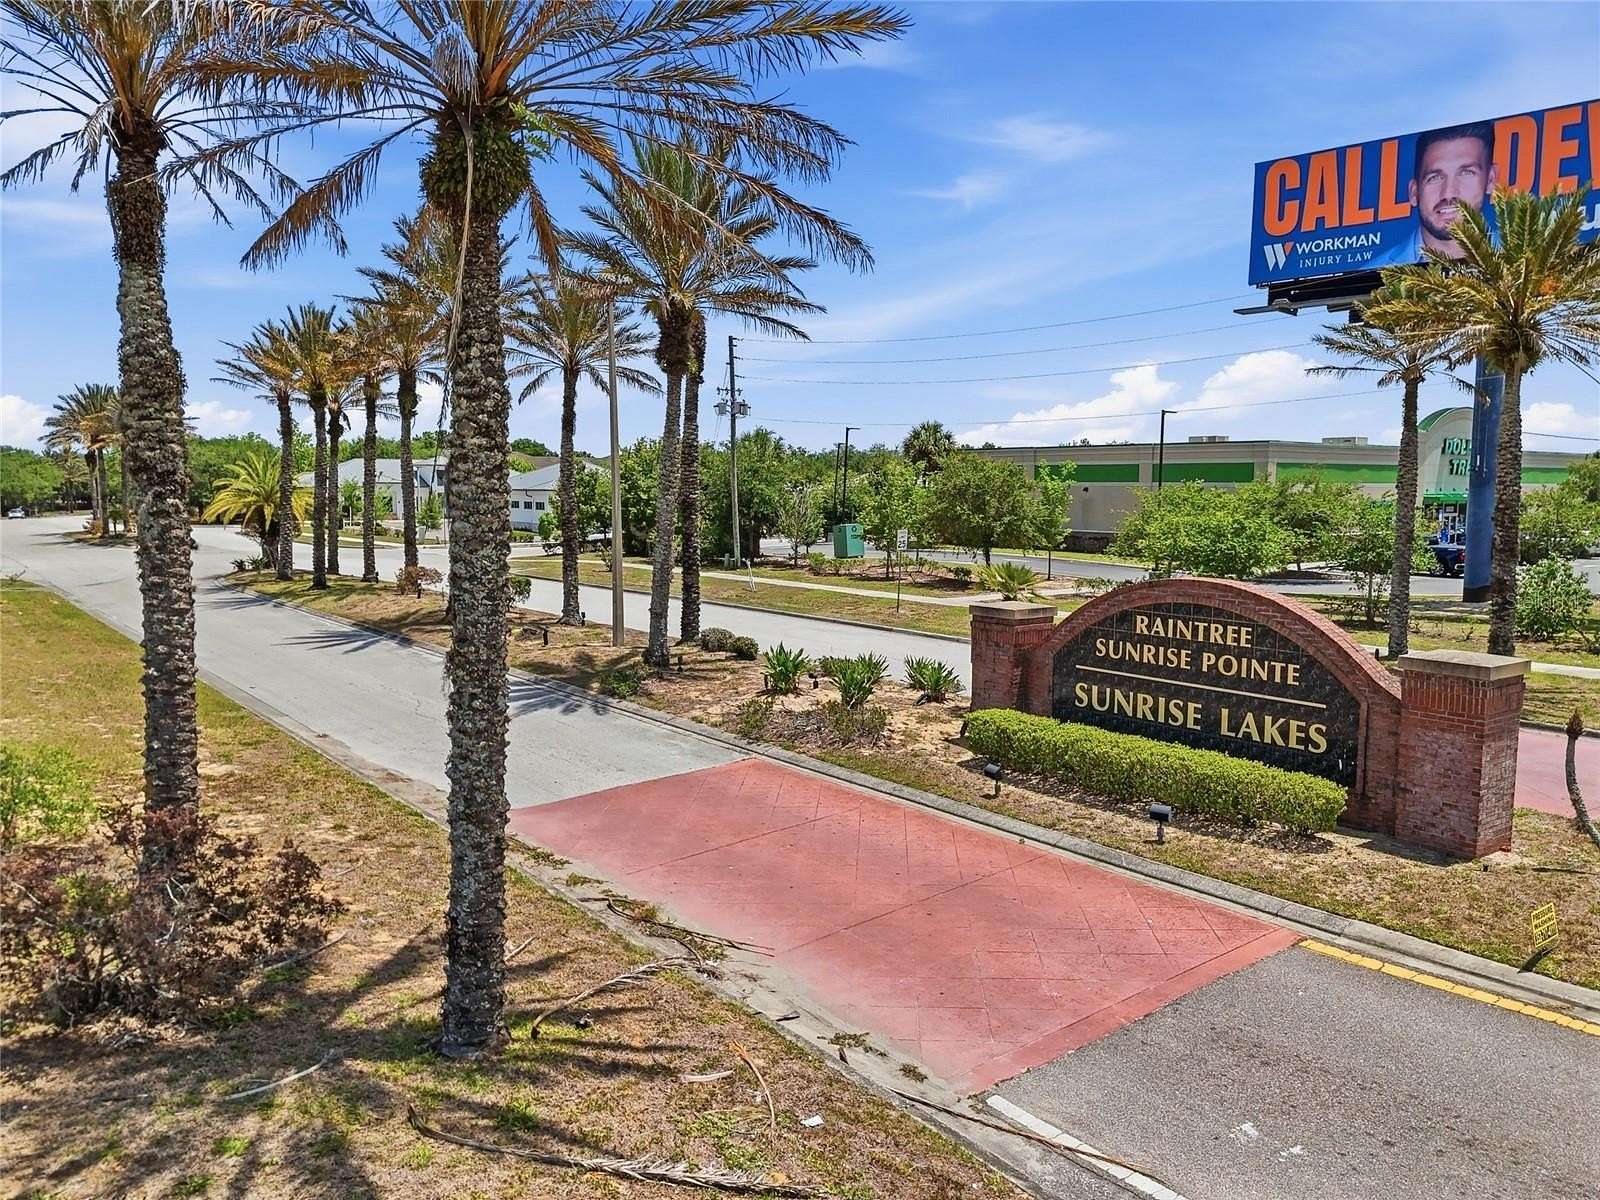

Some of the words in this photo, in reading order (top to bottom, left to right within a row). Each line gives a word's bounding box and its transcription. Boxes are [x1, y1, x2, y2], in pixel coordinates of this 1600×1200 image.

[1264, 139, 1412, 236] CALL
[1295, 232, 1381, 255] WORKMAN
[1299, 255, 1342, 269] INJURY
[1348, 251, 1373, 263] LAW
[1136, 615, 1252, 648] RAINTREE
[1096, 638, 1191, 670] SUNRISE
[1202, 652, 1300, 686] POINTE
[1075, 682, 1202, 730] SUNRISE
[1220, 707, 1327, 754] LAKES
